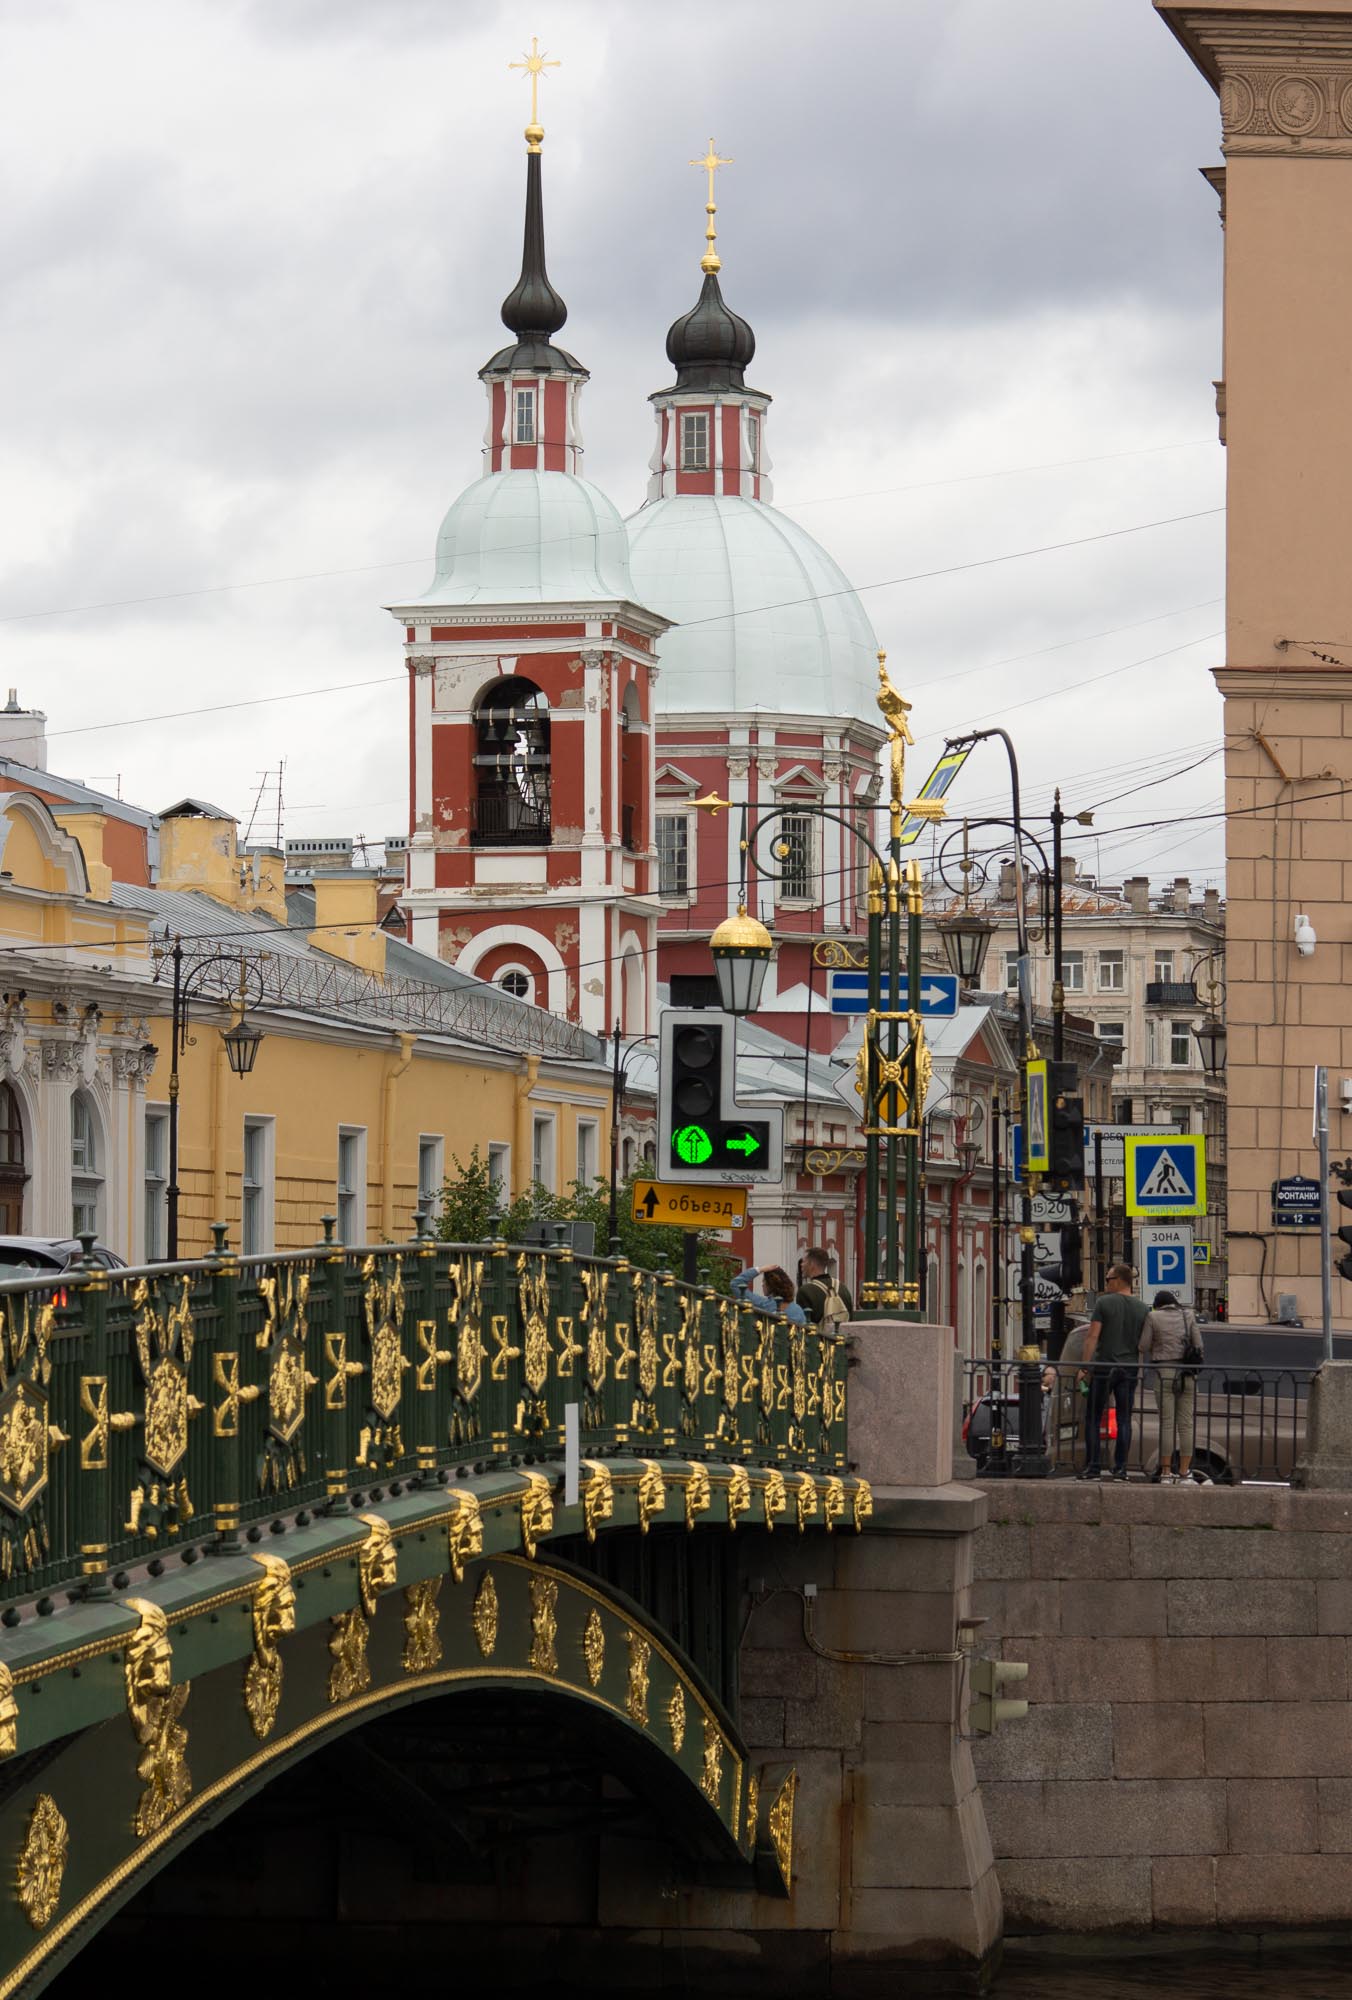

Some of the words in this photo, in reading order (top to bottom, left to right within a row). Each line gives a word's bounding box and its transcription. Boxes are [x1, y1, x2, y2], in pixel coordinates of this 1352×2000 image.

[1277, 1191, 1320, 1201] ФОНТАНКИ
[668, 1194, 733, 1216] объезд
[1033, 1202, 1044, 1213] 15
[1047, 1201, 1064, 1214] 20
[1293, 1213, 1304, 1224] 12
[1151, 1232, 1181, 1242] ЗОНА
